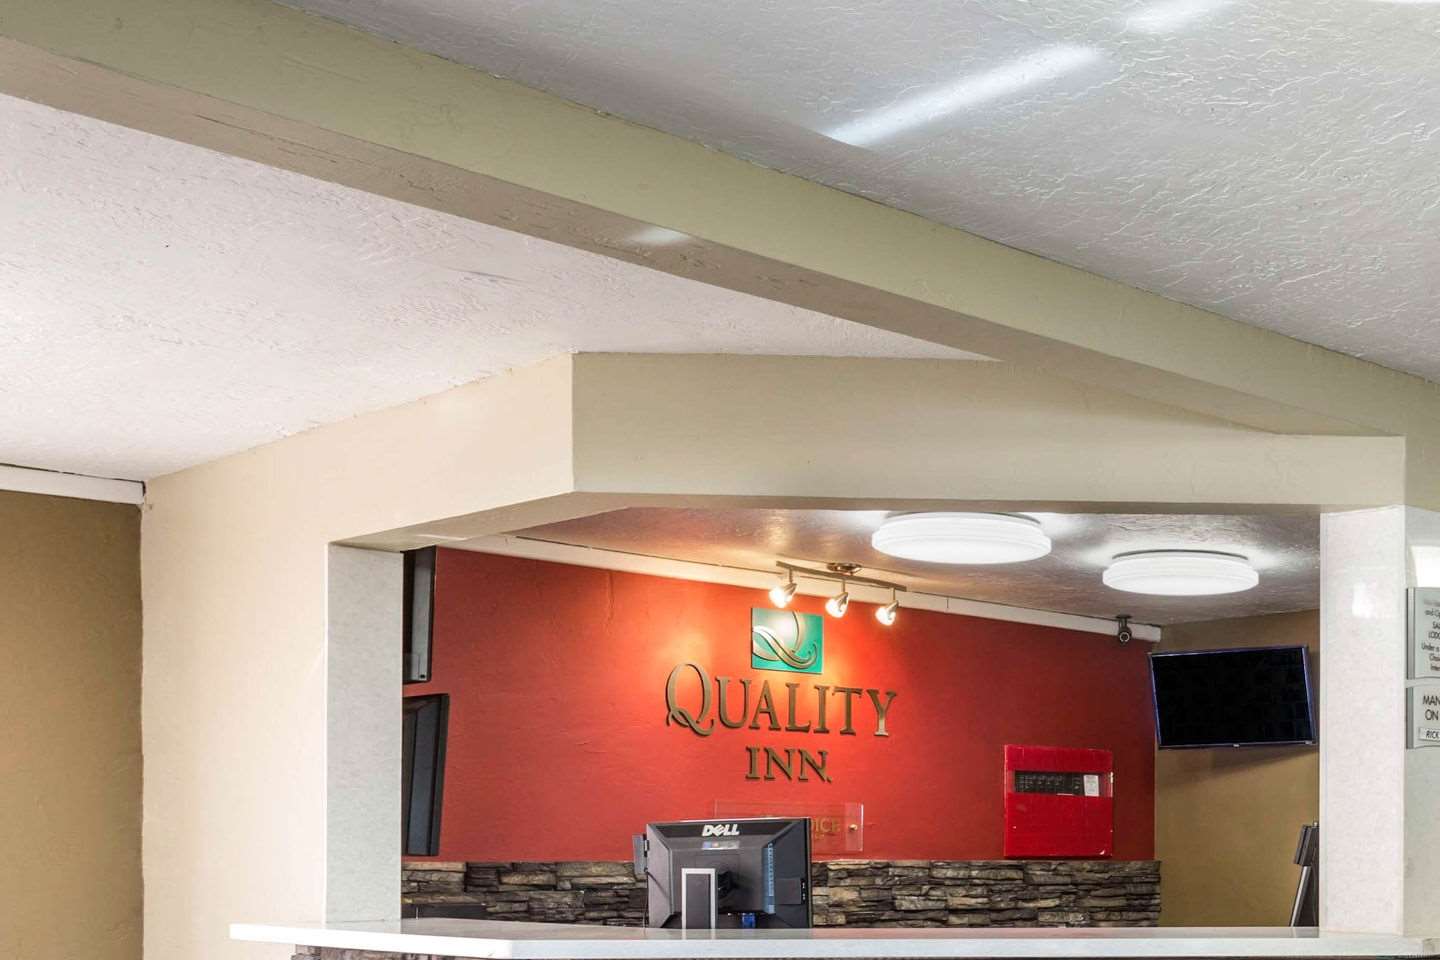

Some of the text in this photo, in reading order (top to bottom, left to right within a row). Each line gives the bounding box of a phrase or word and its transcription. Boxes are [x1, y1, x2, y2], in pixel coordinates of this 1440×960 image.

[1421, 642, 1435, 651] Under
[665, 663, 897, 737] QUALITY
[1424, 709, 1439, 721] ON
[1425, 730, 1439, 740] RICK
[745, 746, 832, 783] INN
[702, 823, 740, 837] DELL
